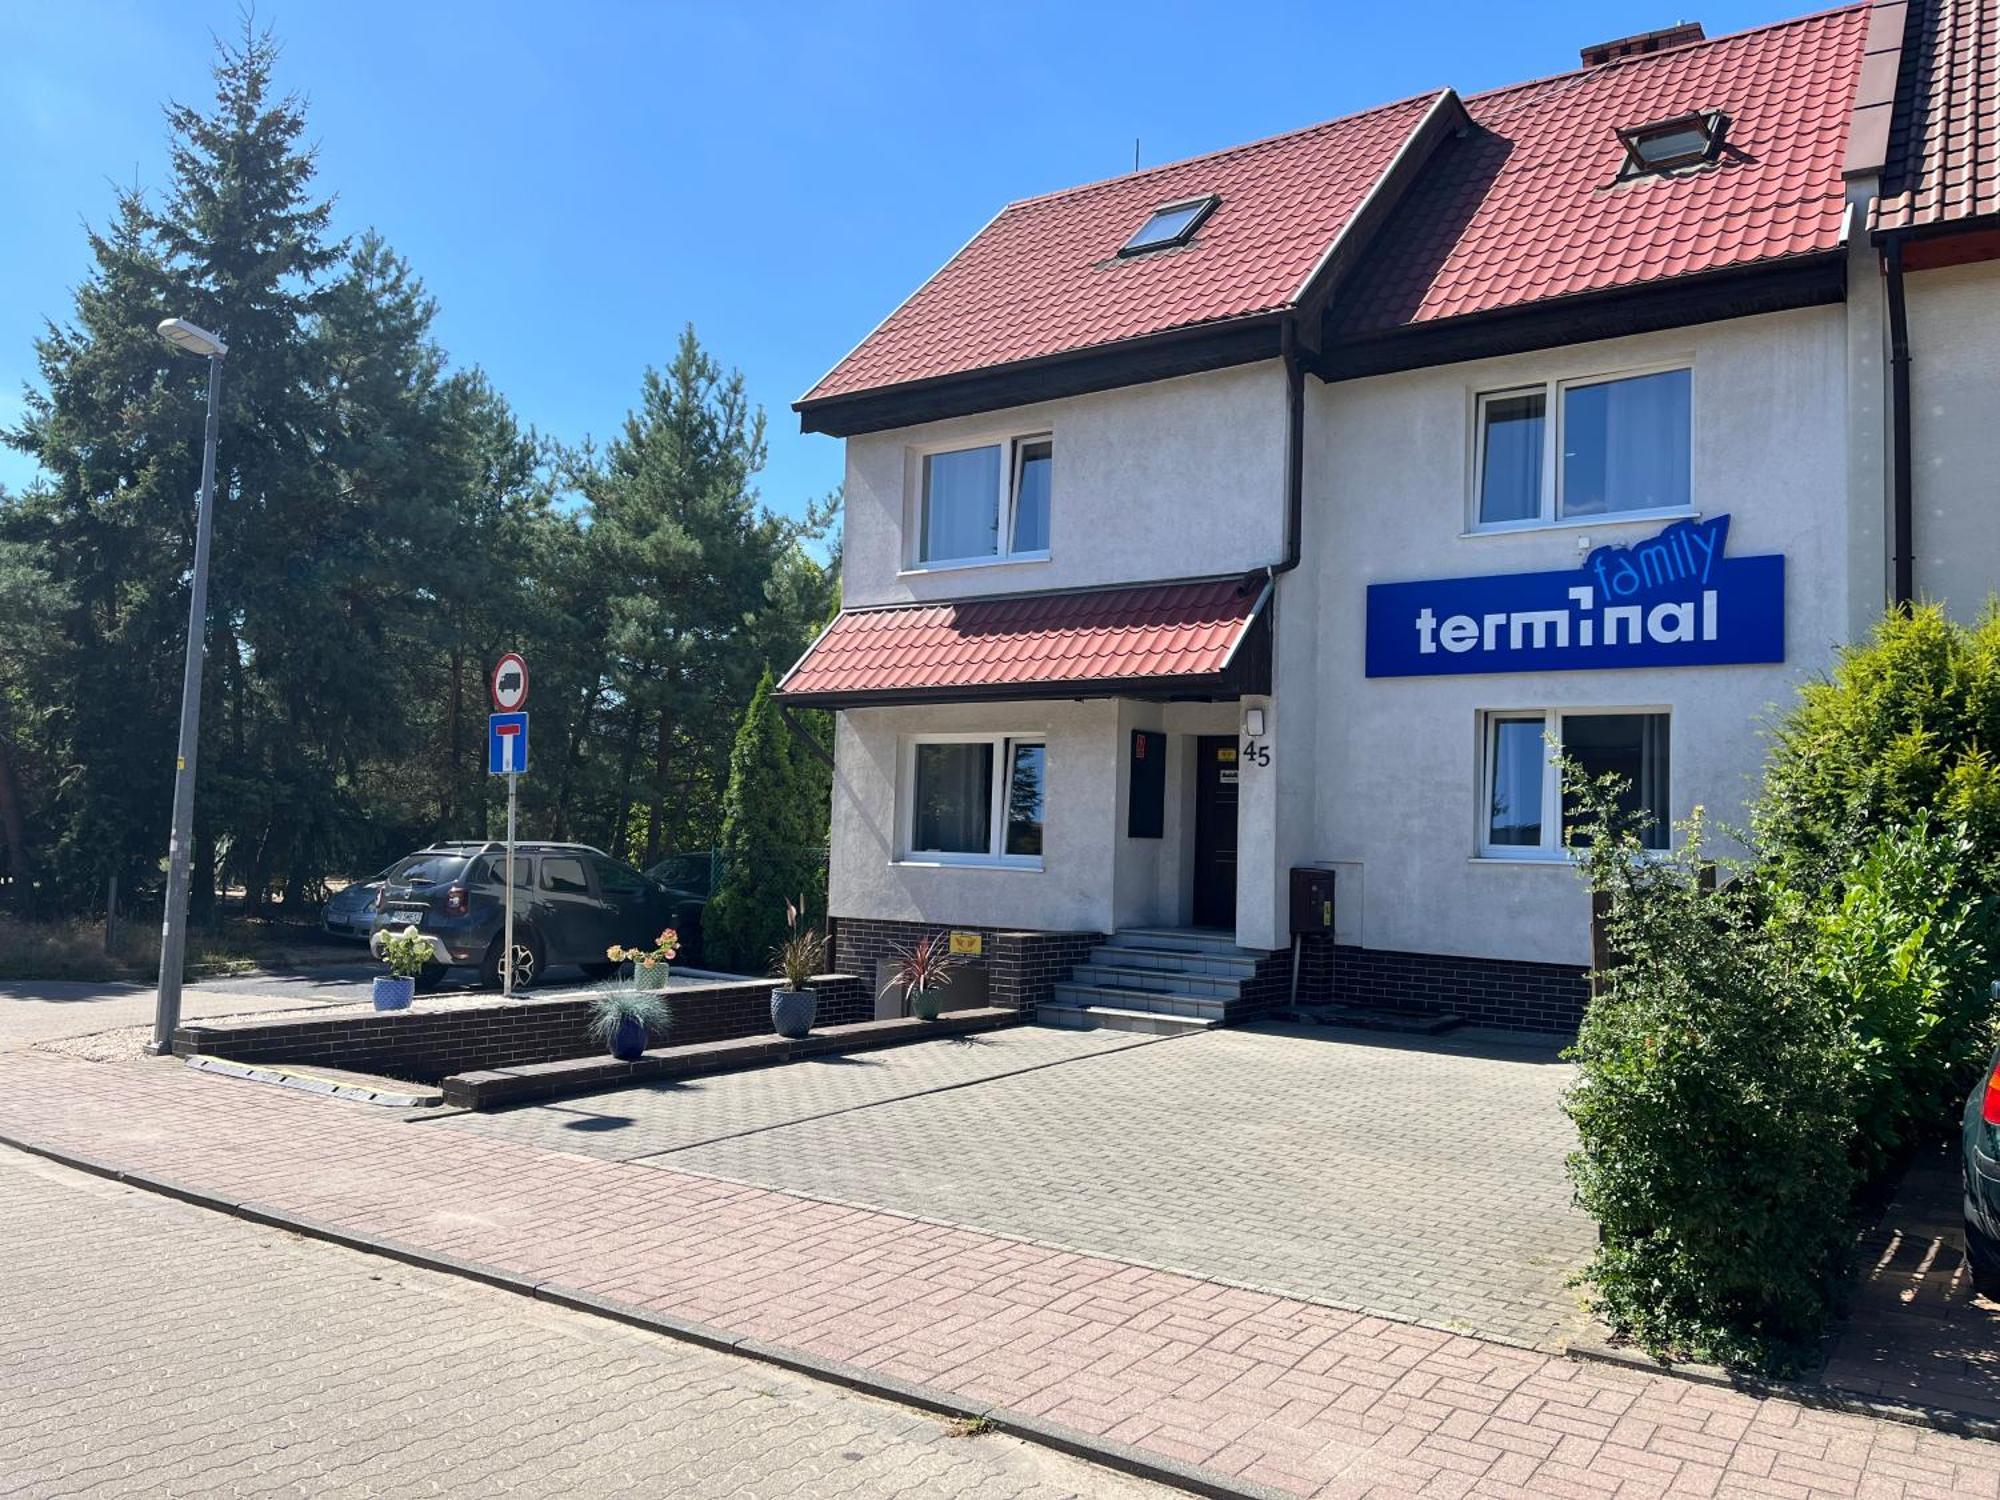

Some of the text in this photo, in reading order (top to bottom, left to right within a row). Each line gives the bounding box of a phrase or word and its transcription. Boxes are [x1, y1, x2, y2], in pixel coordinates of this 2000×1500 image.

[1594, 528, 1716, 599] family
[1416, 586, 1717, 654] terminal
[1244, 741, 1270, 767] 45
